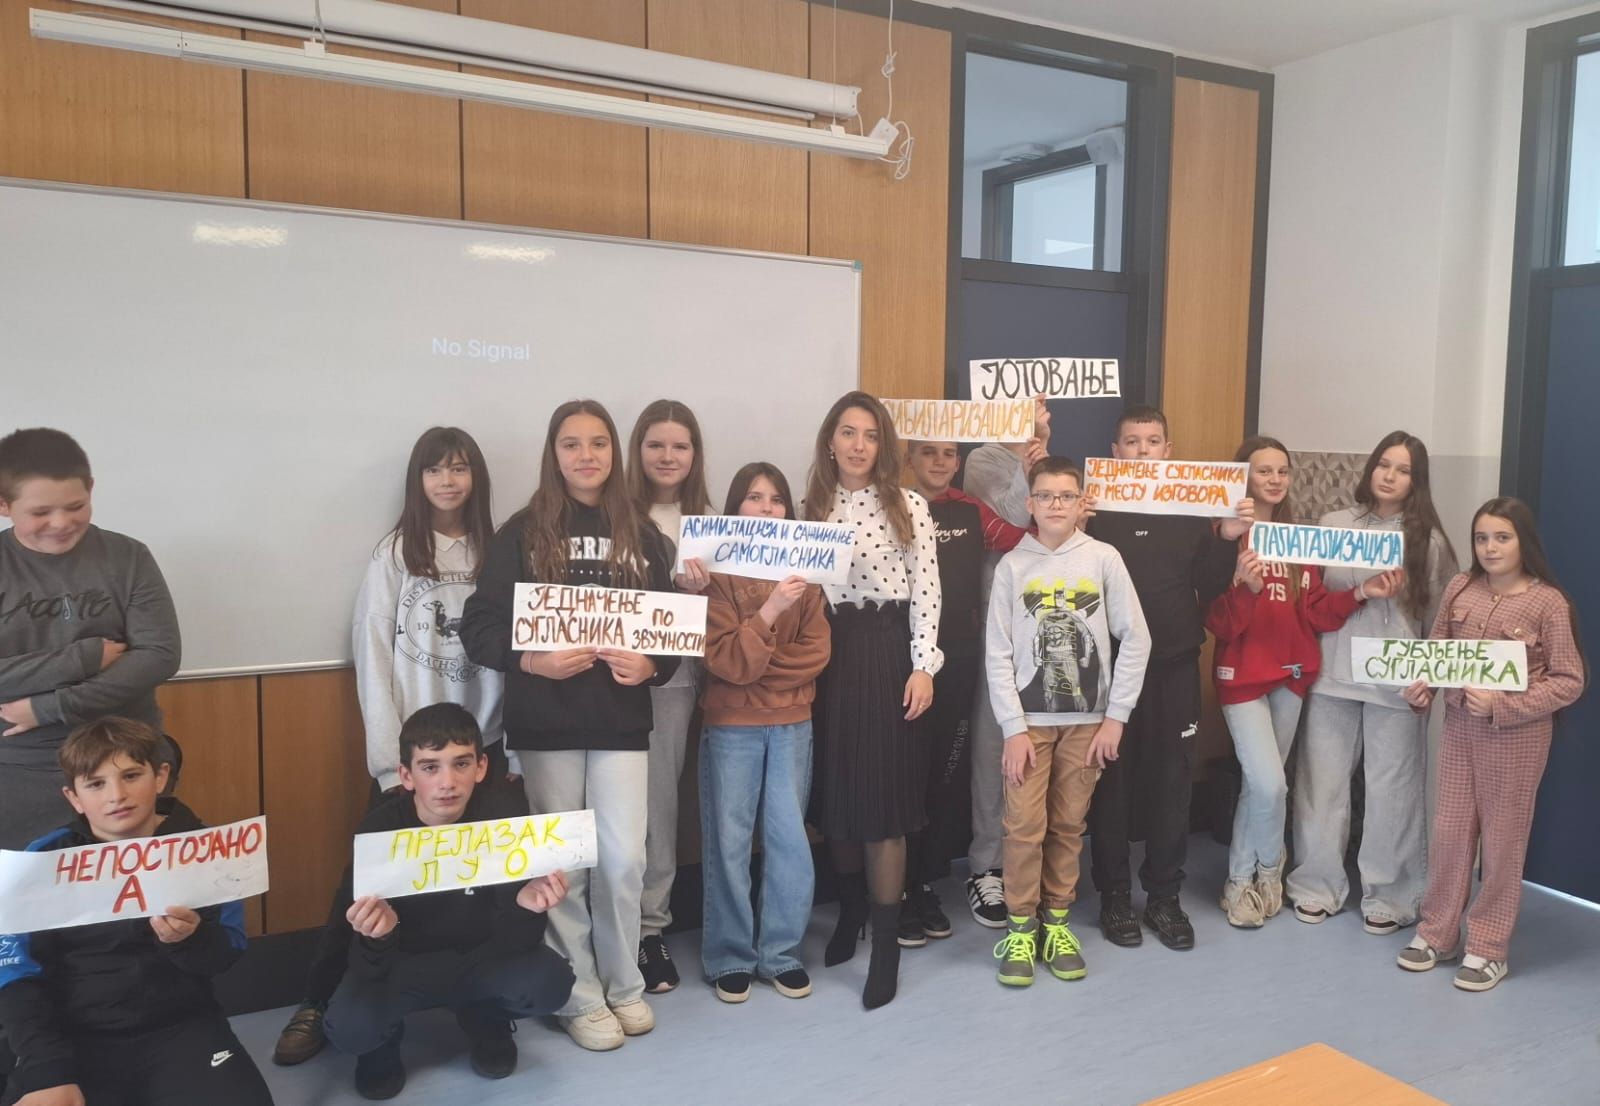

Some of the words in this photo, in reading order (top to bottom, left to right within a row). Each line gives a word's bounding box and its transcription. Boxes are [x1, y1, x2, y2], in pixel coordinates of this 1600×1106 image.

[431, 337, 462, 356] No
[468, 339, 530, 362] Signal
[980, 358, 1118, 400] ЈОТОВАЊЕ
[1087, 459, 1160, 482] ЈЕДНАЧЕЊЕ
[1086, 483, 1100, 499] ПО
[1105, 483, 1147, 501] МЕСТУ
[1153, 484, 1229, 507] ИЗГОВОРА
[780, 524, 790, 540] И
[1253, 523, 1401, 567] ПАЛАТАЛИЗАЦИЈА
[715, 542, 835, 570] САМОГЛАСНИКА
[528, 585, 646, 618] ЈЕДНАЧЕЊЕ
[652, 608, 674, 627] ПО
[1266, 582, 1287, 602] 75
[515, 615, 625, 647] СУГЛАСНИКА
[632, 629, 706, 653] ЗВУЧНОСТИ
[1383, 640, 1492, 660] ГУБЉЕЊЕ
[1365, 656, 1520, 685] СУГЛАСНИКА
[55, 822, 263, 884] НЕПОСТОЈАНО
[391, 816, 565, 861] ПРЕЛАЗАК
[412, 860, 439, 890] Л
[457, 856, 480, 882] У
[504, 847, 529, 877] О
[112, 874, 148, 913] А
